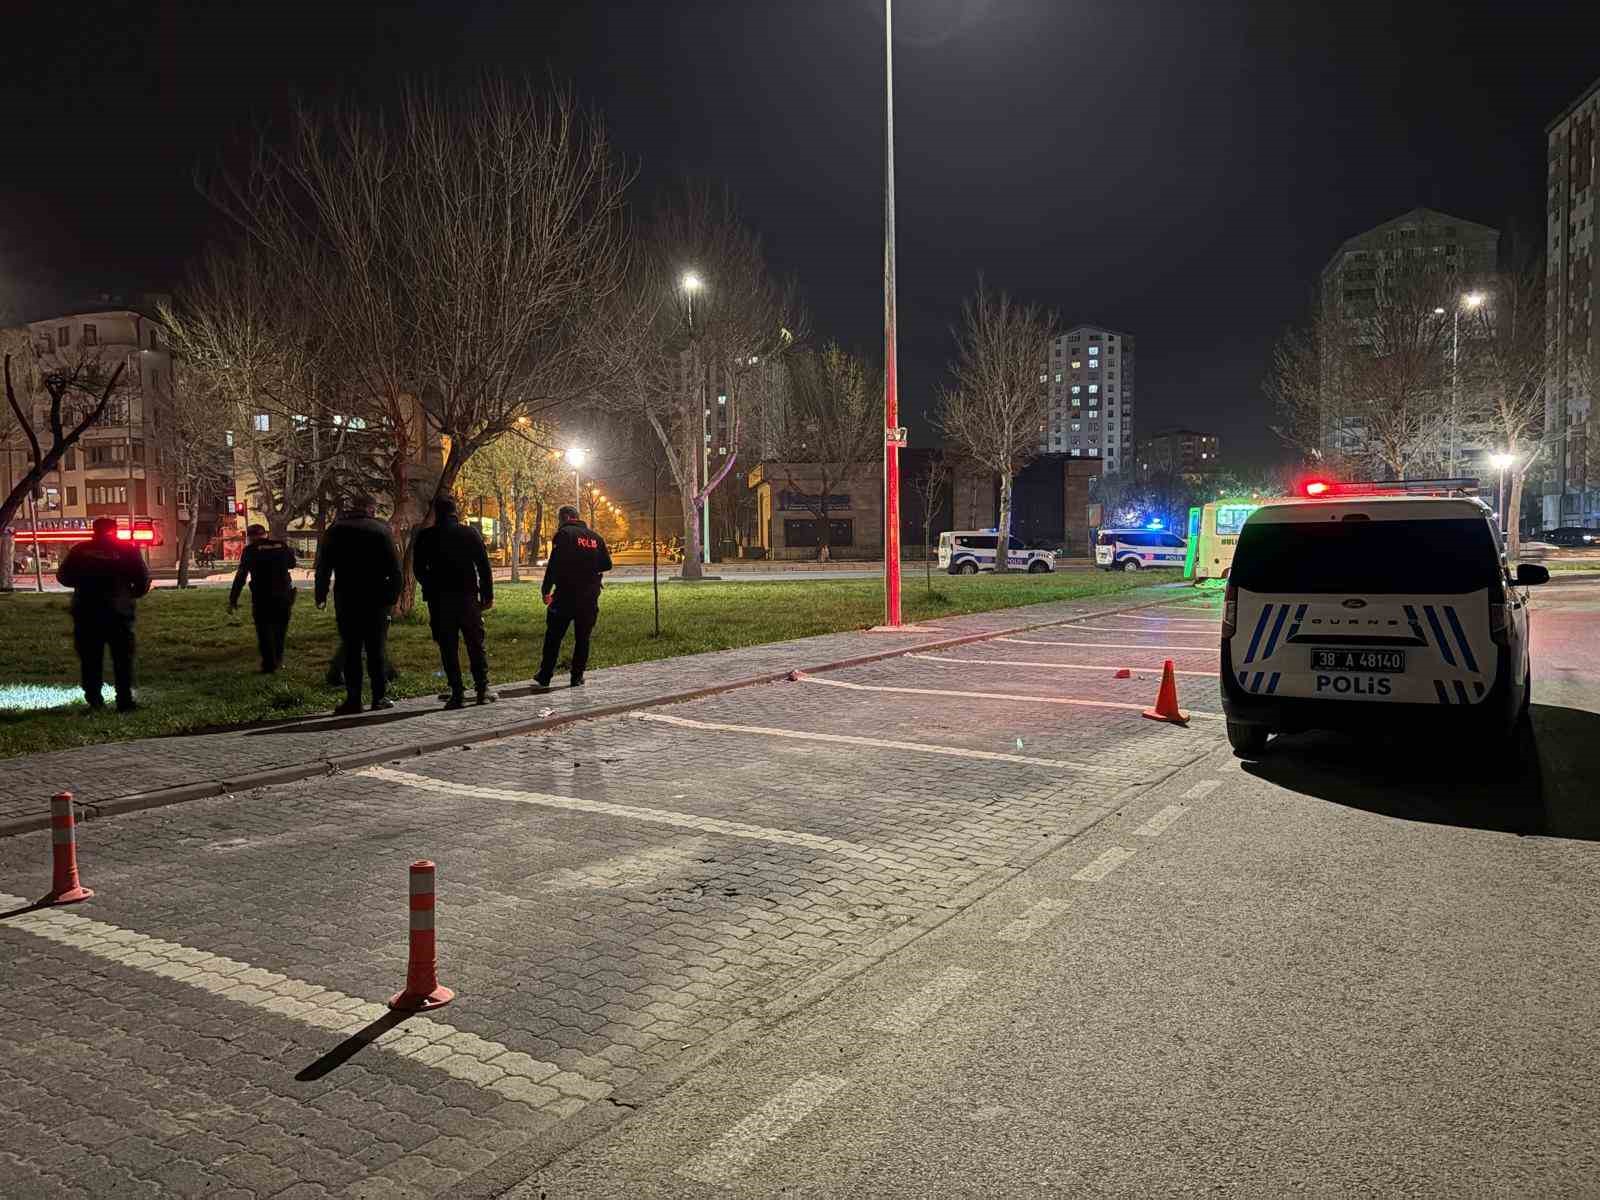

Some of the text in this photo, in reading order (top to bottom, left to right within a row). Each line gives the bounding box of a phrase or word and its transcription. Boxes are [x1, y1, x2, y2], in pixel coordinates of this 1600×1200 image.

[1319, 652, 1400, 668] 38 A 48140
